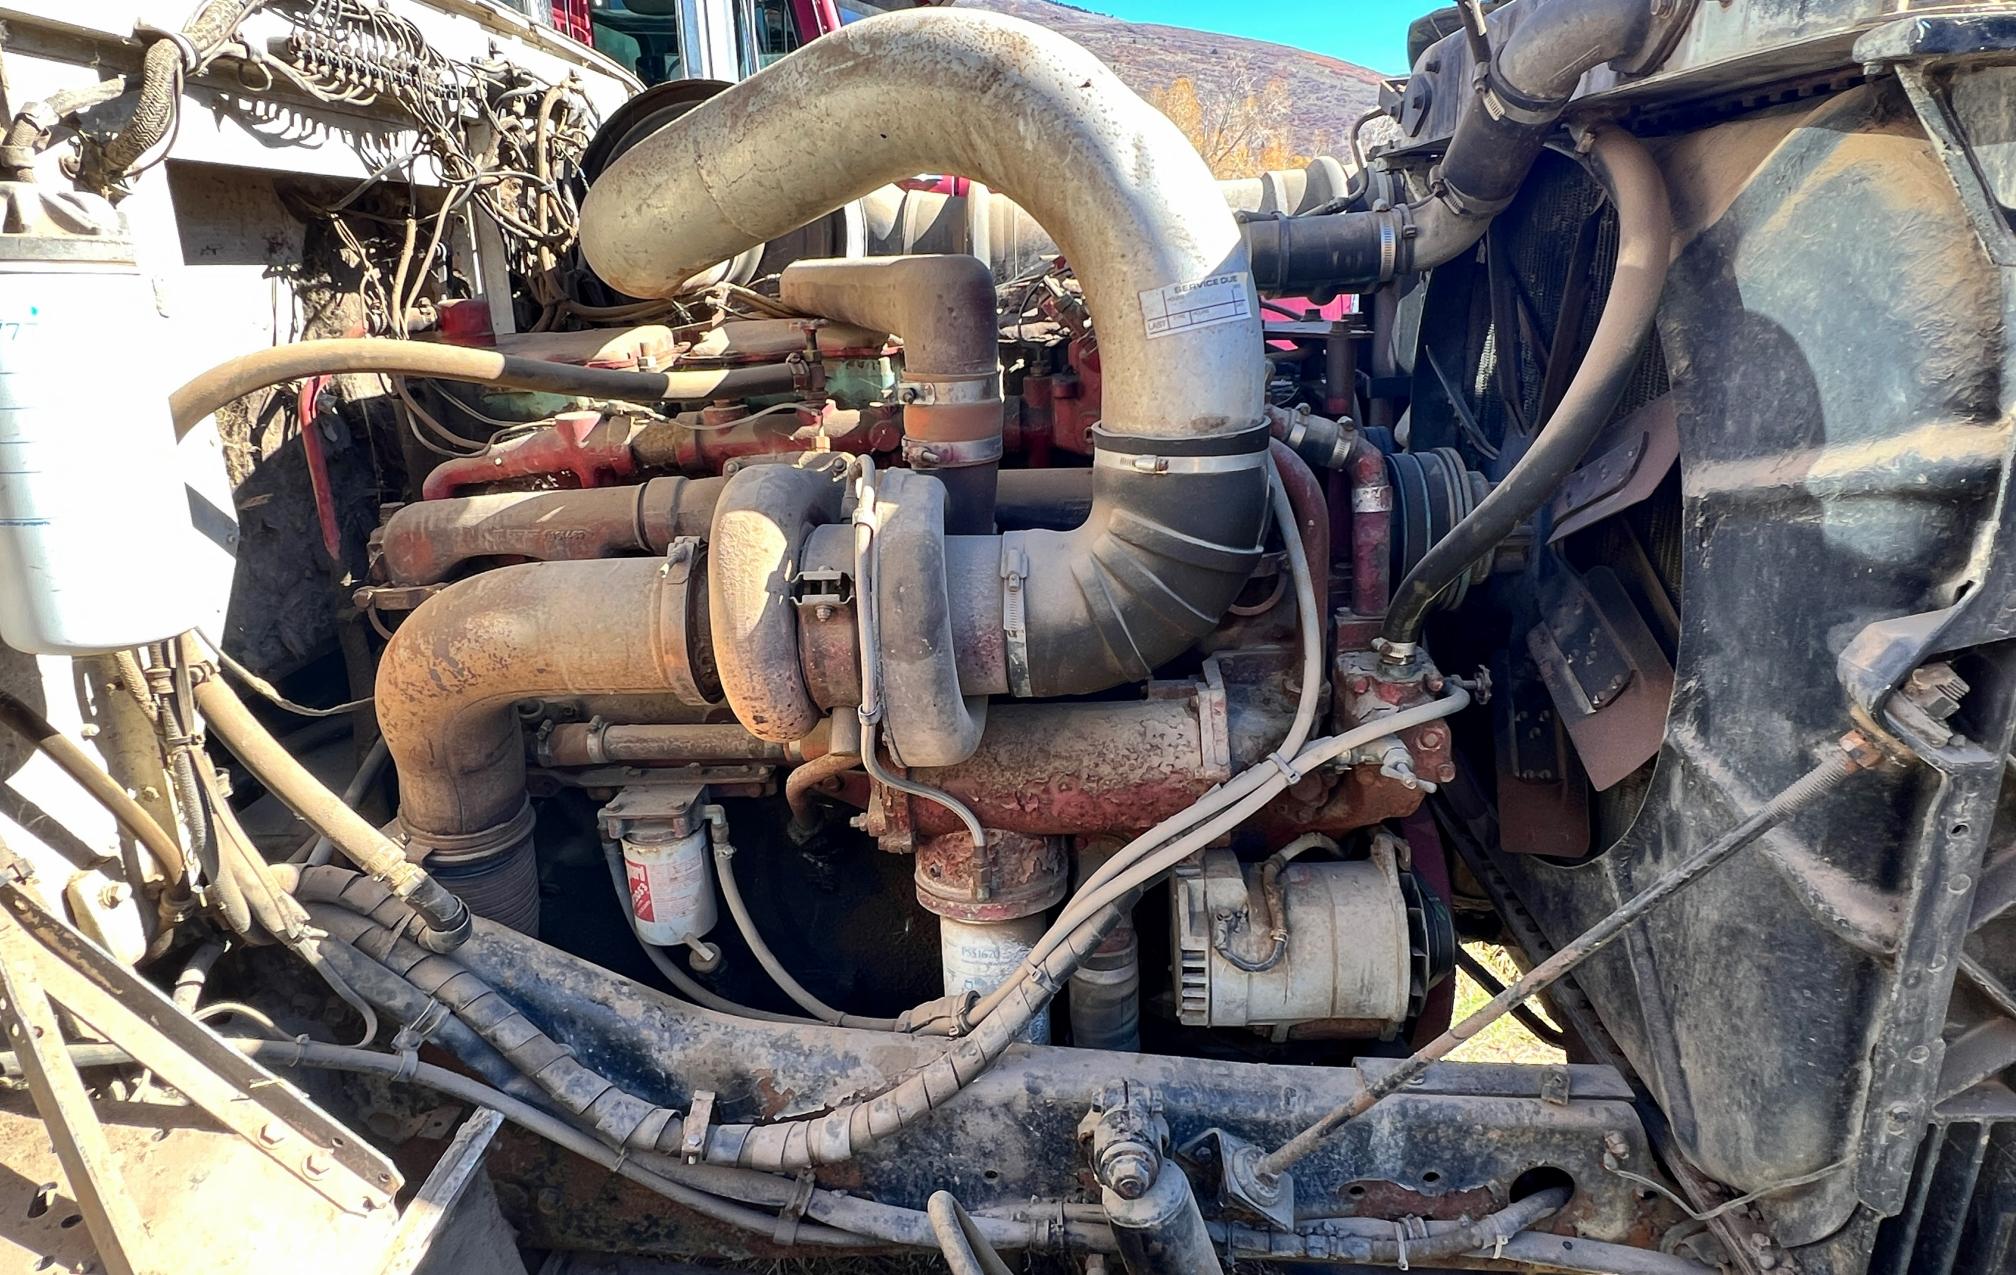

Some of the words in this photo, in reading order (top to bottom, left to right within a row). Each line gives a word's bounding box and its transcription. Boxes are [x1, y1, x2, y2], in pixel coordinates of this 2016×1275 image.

[1174, 278, 1219, 294] SERVICE
[1220, 275, 1238, 285] DUE
[1147, 320, 1167, 331] LAST
